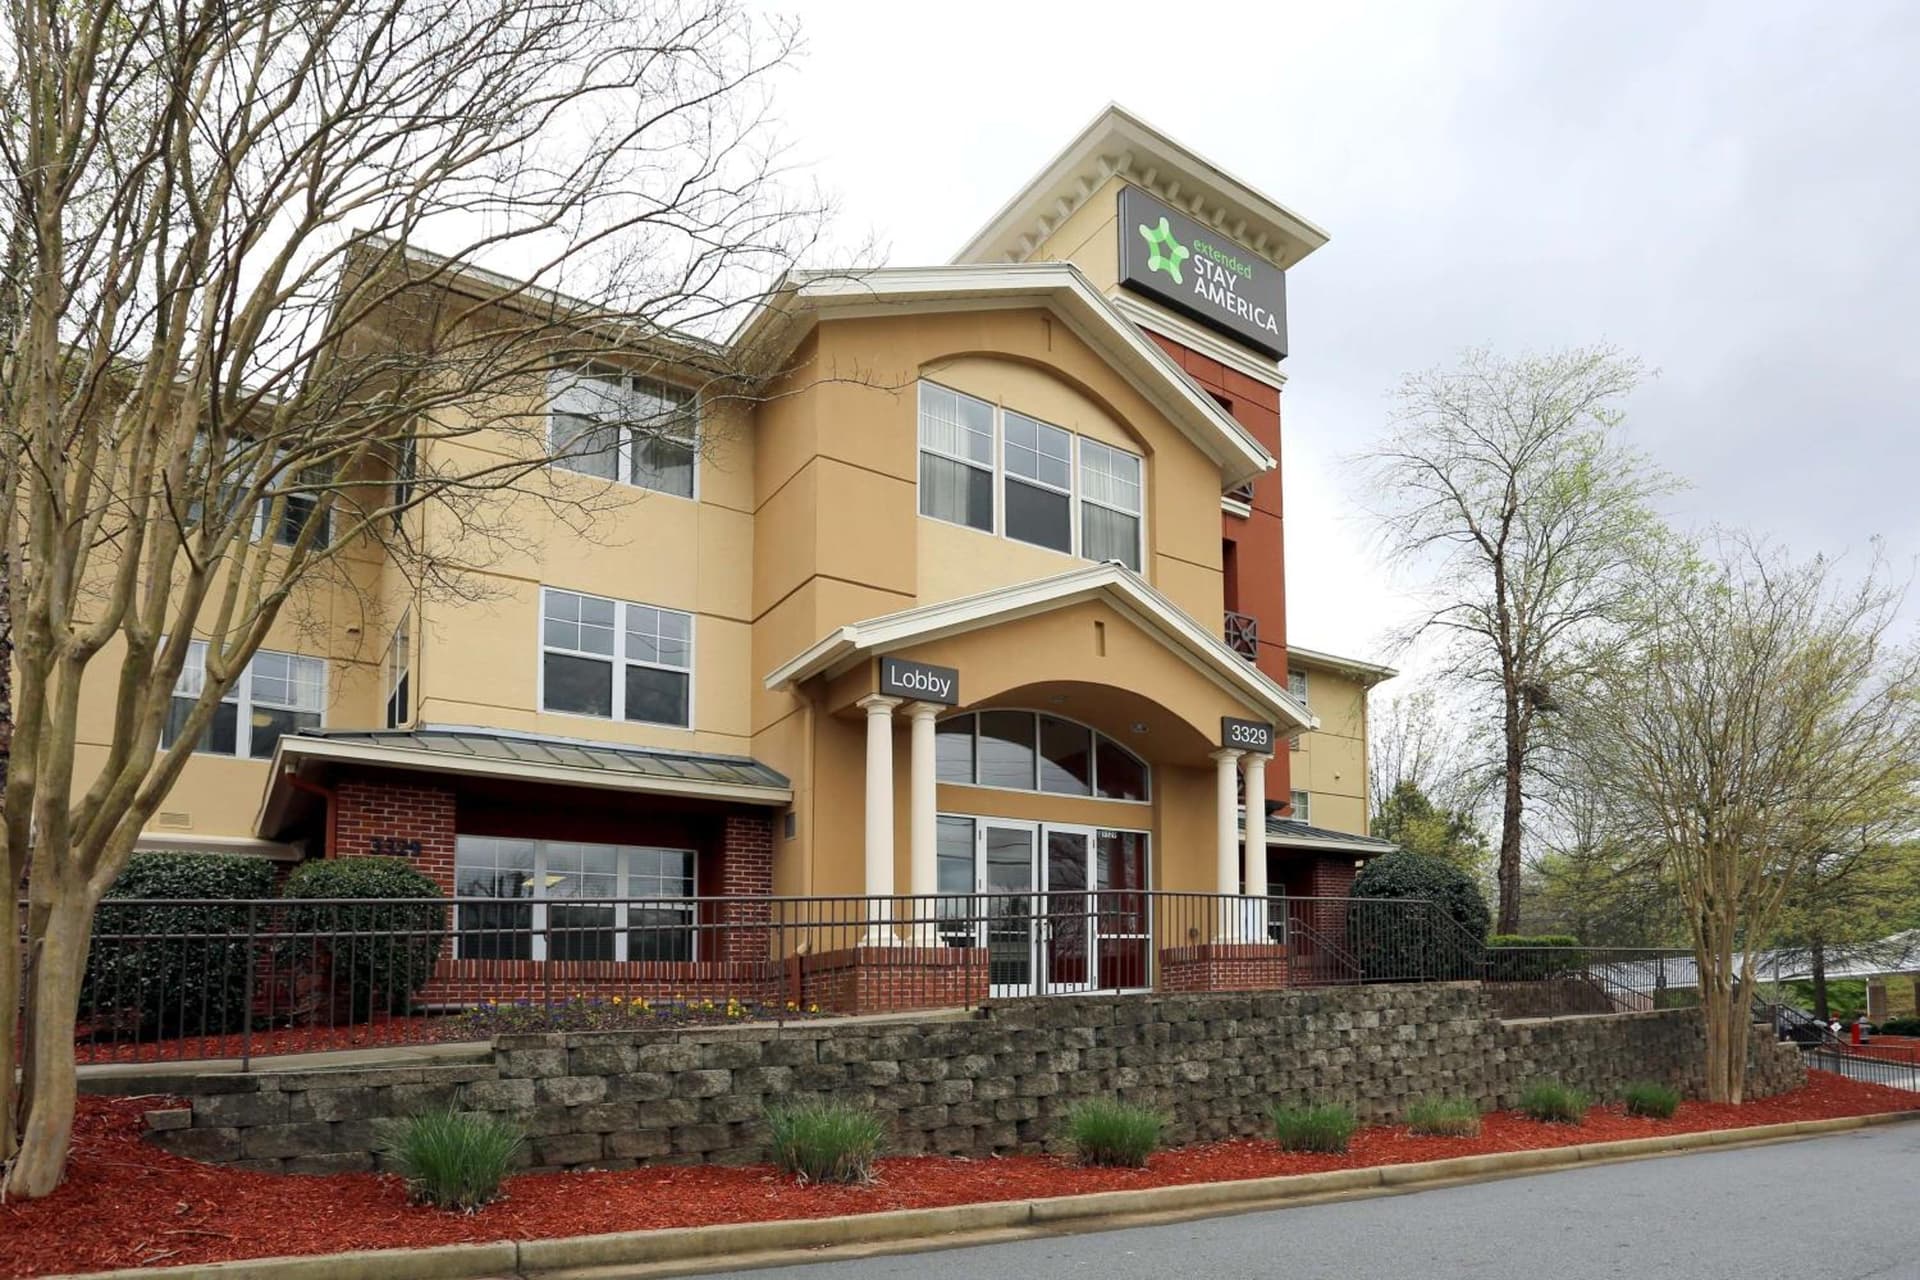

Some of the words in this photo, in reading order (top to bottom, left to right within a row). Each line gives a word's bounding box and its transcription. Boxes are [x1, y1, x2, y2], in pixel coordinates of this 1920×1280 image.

[1194, 239, 1252, 279] extended
[1194, 254, 1237, 291] STAY
[1194, 277, 1279, 335] AMERICA
[891, 665, 951, 697] Lobby
[1232, 725, 1268, 745] 3329
